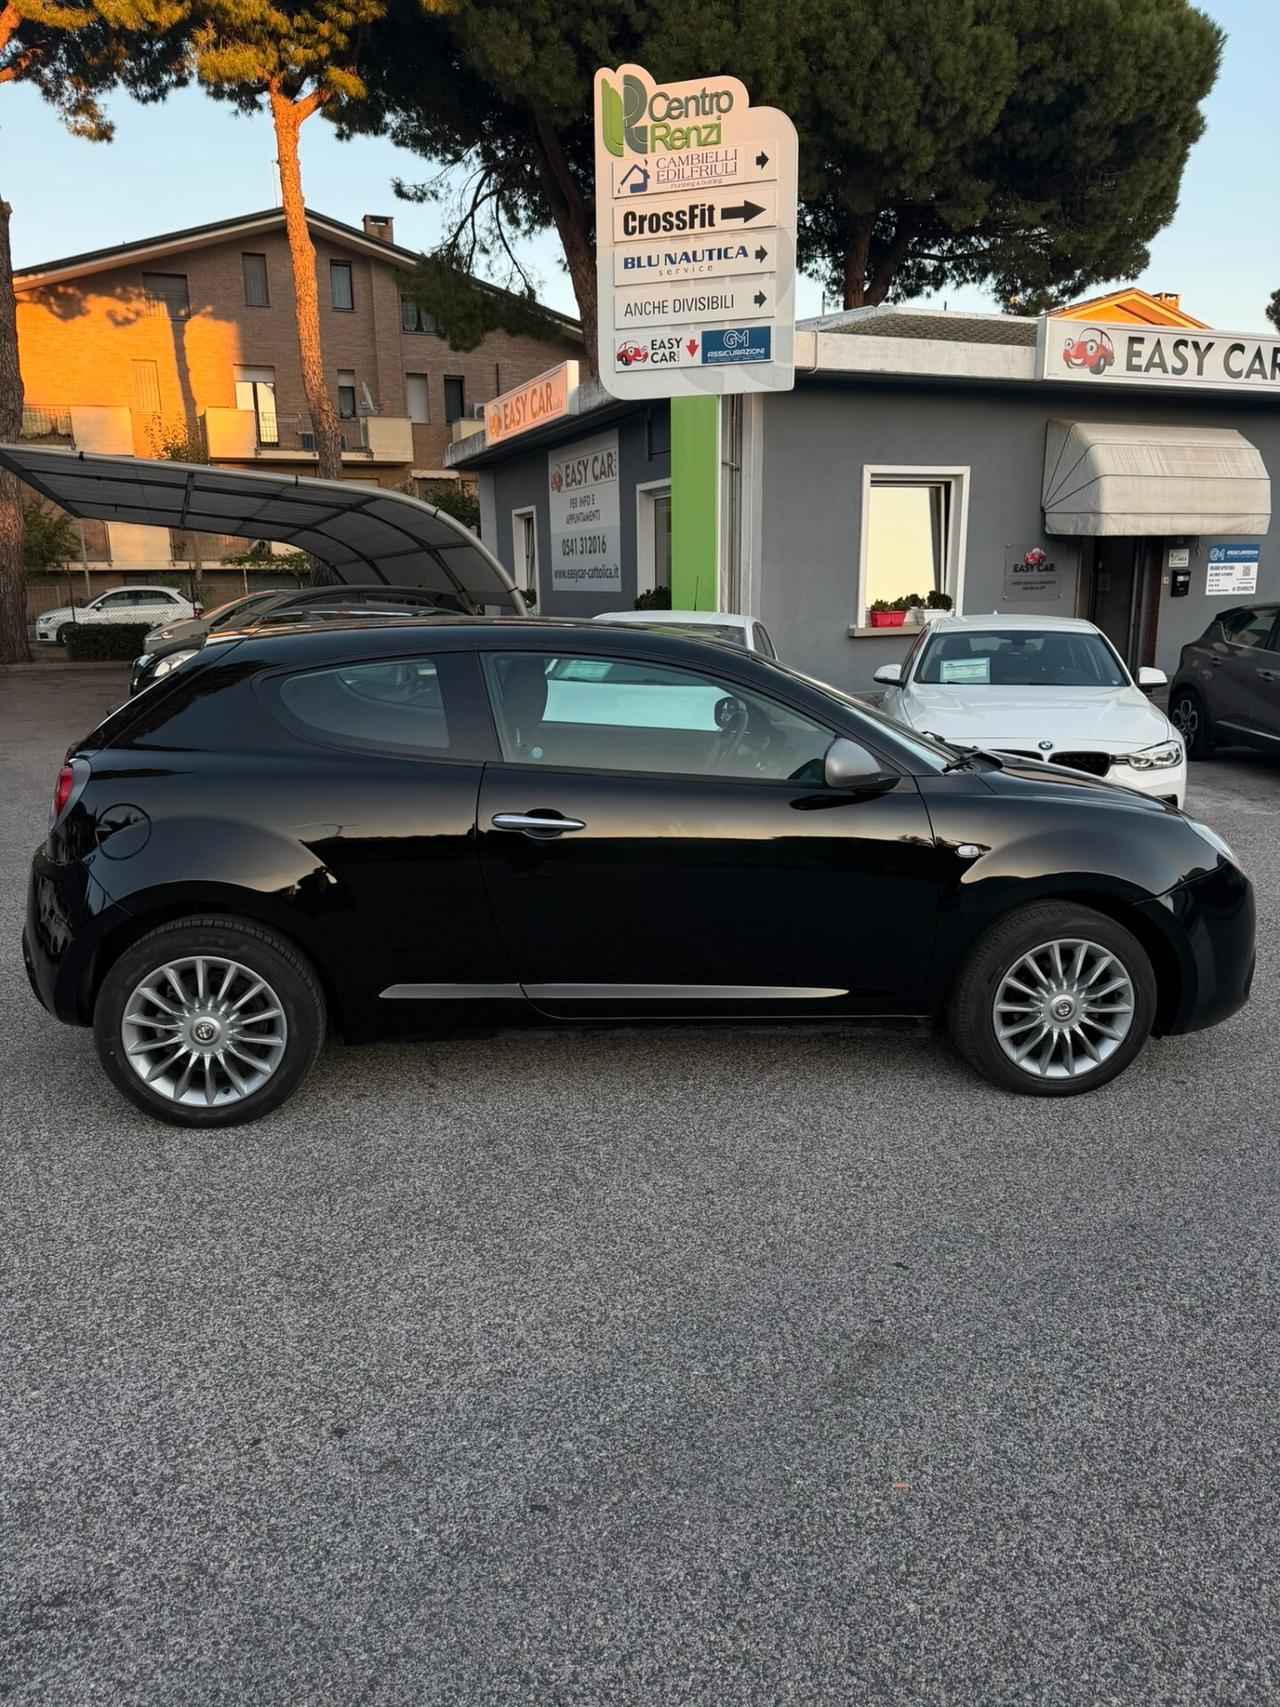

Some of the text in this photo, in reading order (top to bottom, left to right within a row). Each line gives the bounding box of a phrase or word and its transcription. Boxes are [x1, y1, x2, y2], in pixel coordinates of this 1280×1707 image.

[648, 86, 735, 122] Centro
[650, 115, 722, 153] Renzi
[656, 148, 738, 169] CAMBIELLI
[656, 161, 738, 182] EDILFRIULI
[623, 203, 716, 236] CrossFit
[623, 245, 749, 270] BLU NAUTICA
[658, 264, 713, 276] service
[624, 294, 735, 317] ANCHE DIVISIBILI
[651, 337, 683, 351] EASY
[723, 329, 750, 348] GM
[651, 351, 677, 364] CAR
[707, 347, 765, 358] ASSICURAZIONI
[1125, 335, 1216, 376] EASY
[503, 382, 553, 430] EASY CAR
[564, 458, 590, 487] EASY
[591, 451, 615, 482] CAR
[569, 493, 596, 509] PER INFO E
[566, 509, 601, 525] APPUNTAMENTI
[561, 535, 607, 557] 0541 312016
[553, 563, 619, 583] www.easycar-cattolica.it
[1013, 561, 1057, 573] EASY CAR
